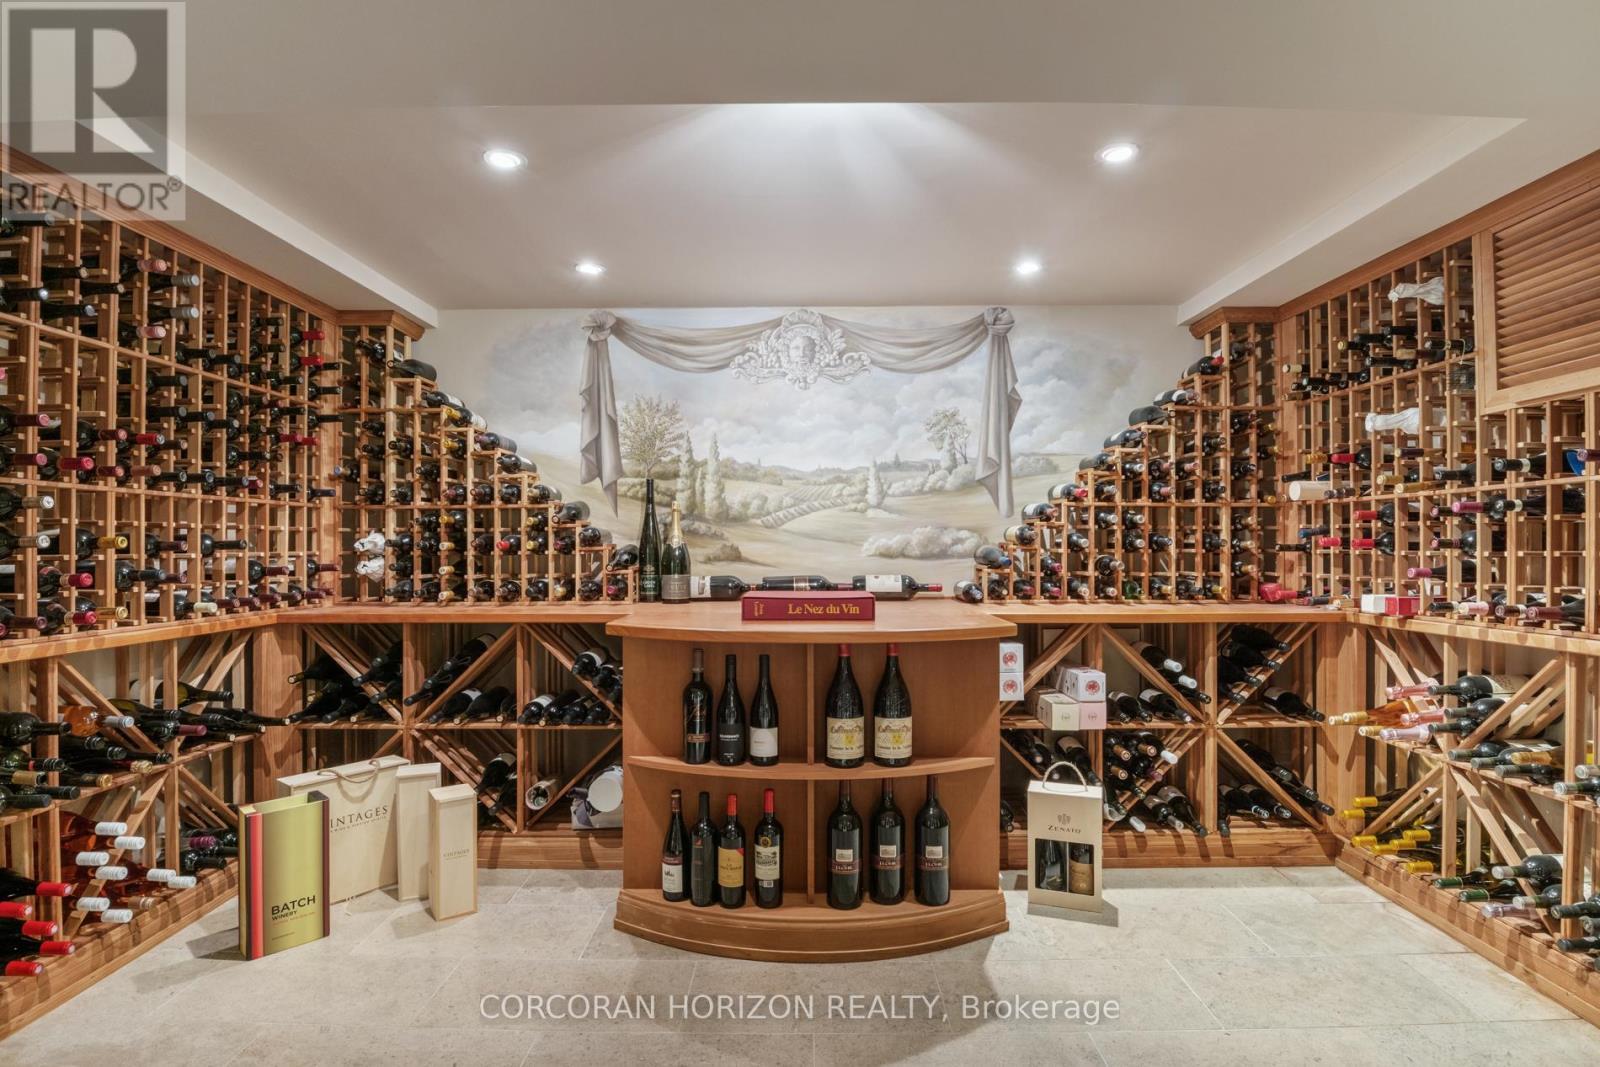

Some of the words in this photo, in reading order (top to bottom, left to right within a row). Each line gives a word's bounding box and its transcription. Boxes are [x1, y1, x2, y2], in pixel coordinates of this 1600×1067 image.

[788, 603, 802, 614] Le
[804, 603, 824, 614] Nez
[826, 603, 840, 614] du
[841, 603, 860, 614] Vin
[330, 805, 388, 829] INTAGES
[271, 895, 316, 916] BATCH
[271, 910, 297, 921] WINERY
